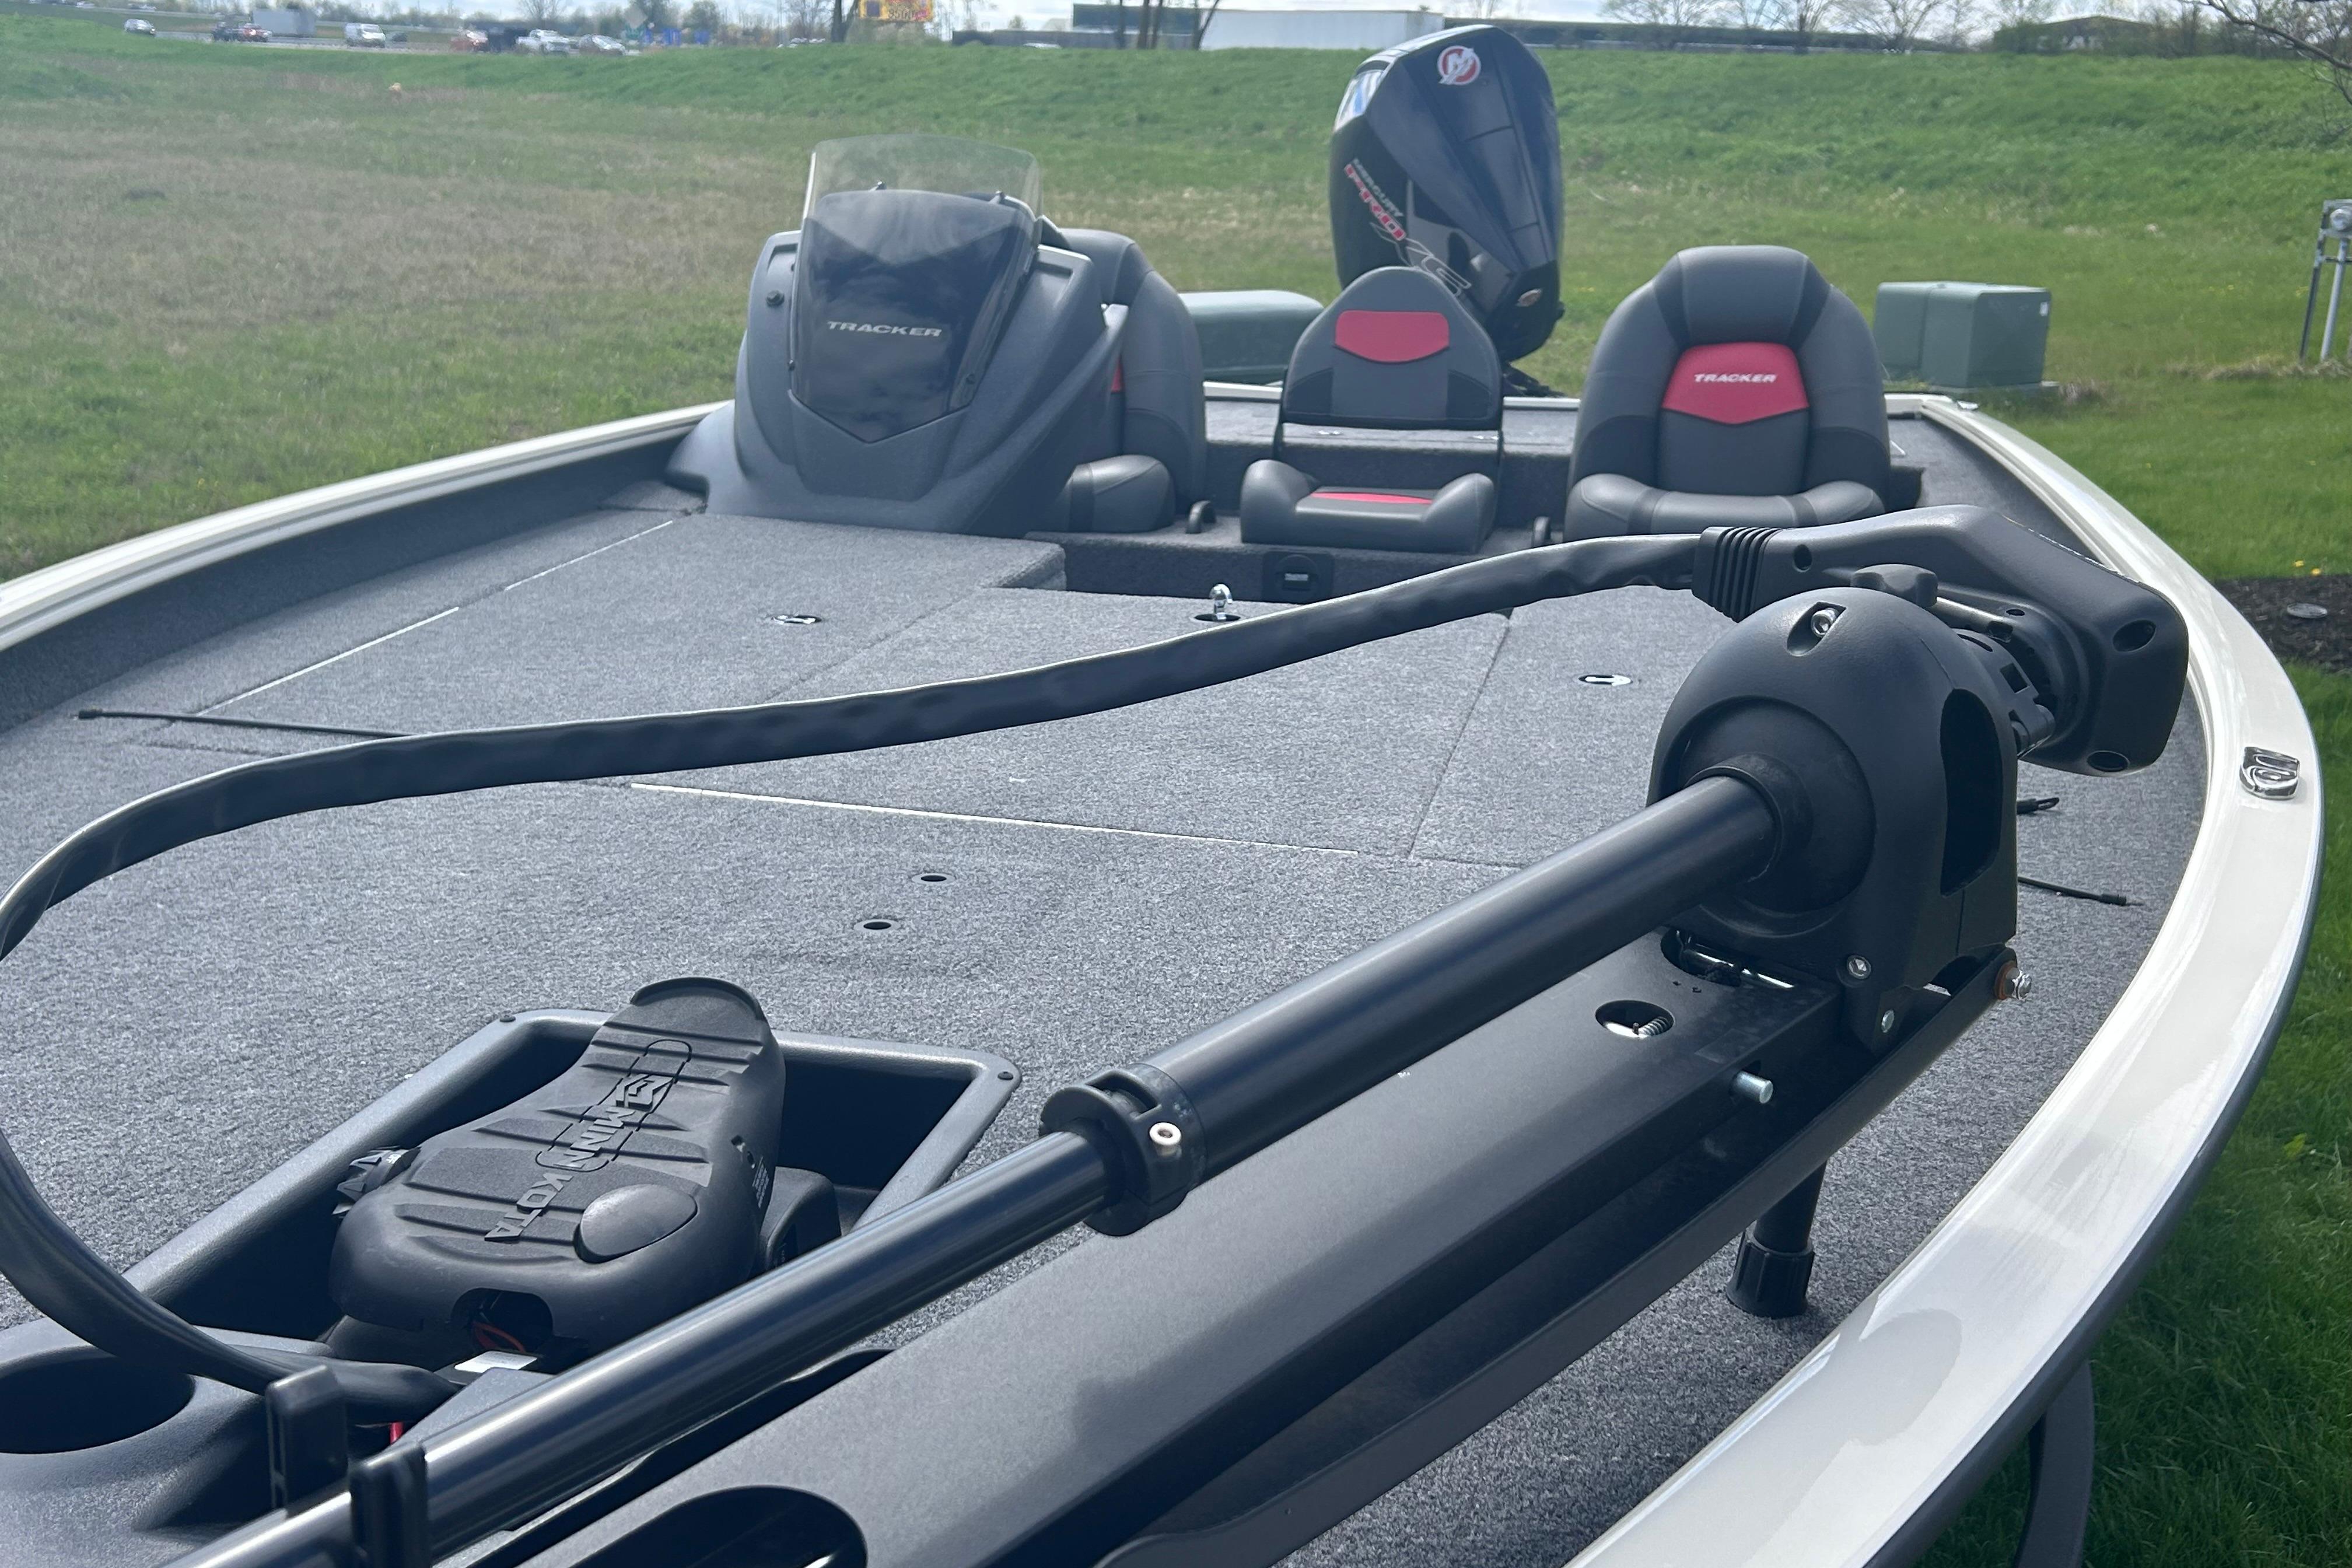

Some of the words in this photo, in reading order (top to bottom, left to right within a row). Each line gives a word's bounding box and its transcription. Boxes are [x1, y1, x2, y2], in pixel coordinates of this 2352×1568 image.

[1353, 157, 1404, 217] MERCURY
[827, 320, 943, 337] TRACKER
[1693, 373, 1777, 383] TRACKER
[553, 1107, 636, 1170] MINN
[484, 1172, 574, 1242] KOTA
